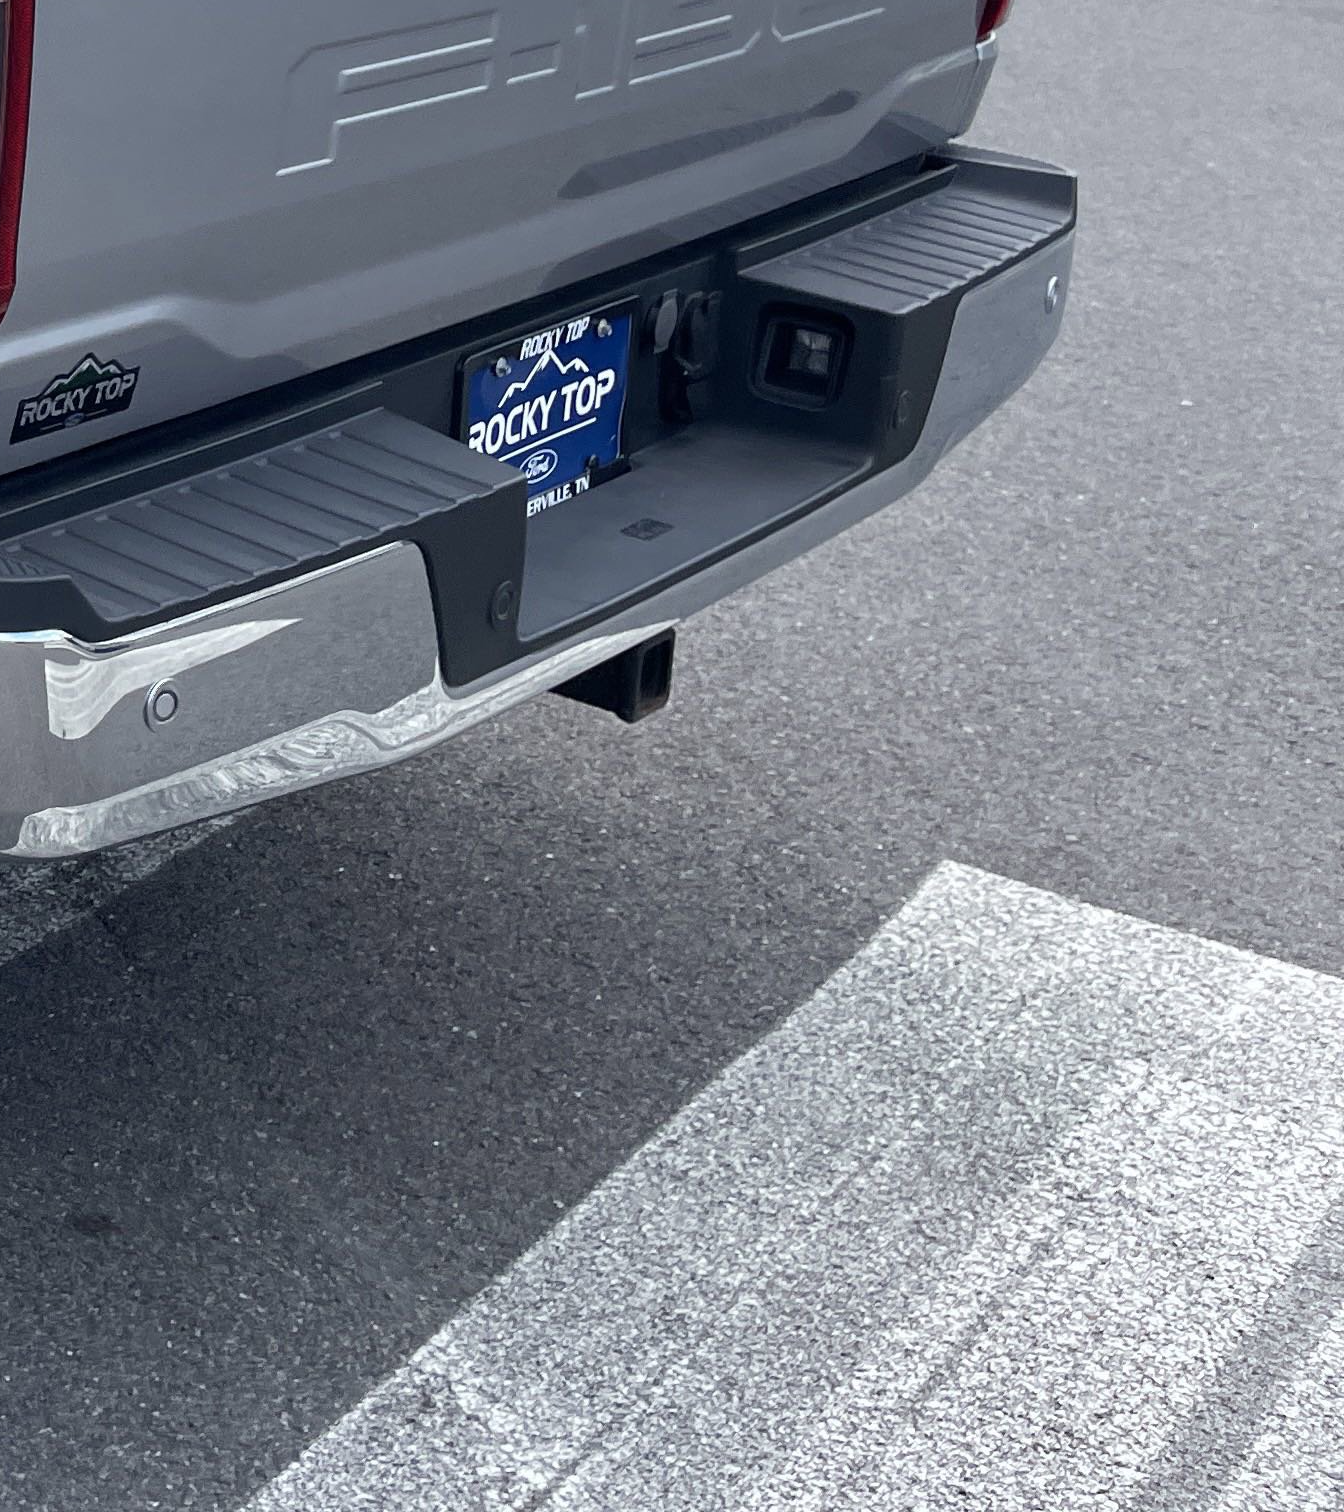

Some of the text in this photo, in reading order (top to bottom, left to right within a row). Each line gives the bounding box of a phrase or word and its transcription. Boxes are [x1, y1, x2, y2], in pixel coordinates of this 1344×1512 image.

[520, 315, 591, 361] ROCKY TOP
[19, 384, 93, 427] ROCKY
[95, 373, 136, 405] TOP
[468, 368, 616, 455] ROCKY TOP
[525, 454, 551, 479] Ford
[574, 474, 591, 495] TN
